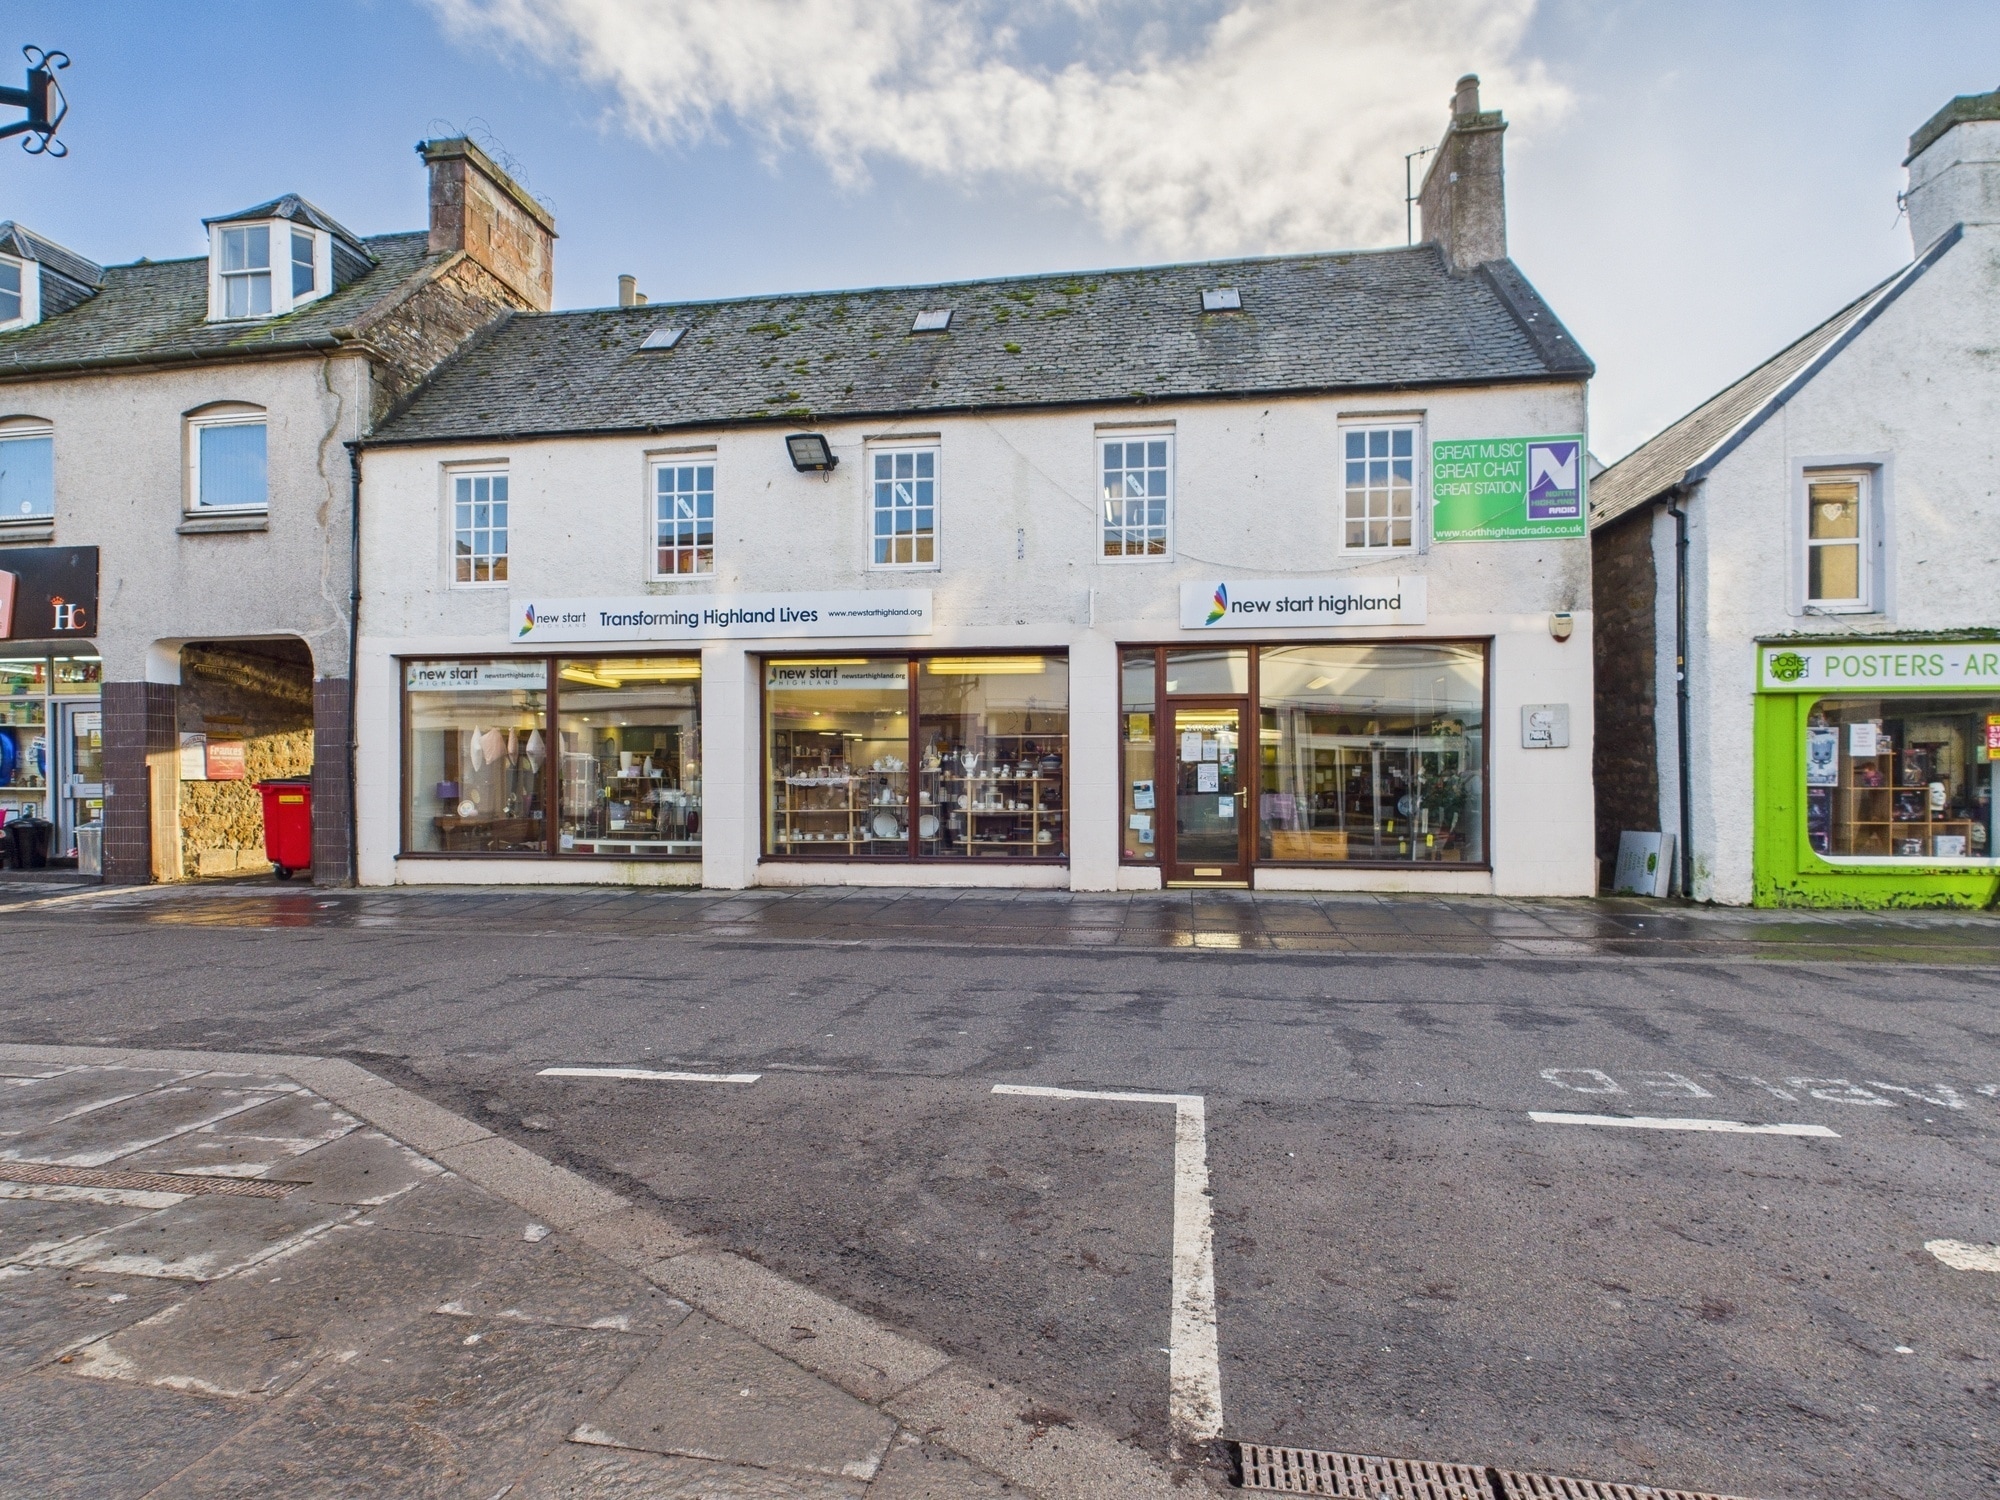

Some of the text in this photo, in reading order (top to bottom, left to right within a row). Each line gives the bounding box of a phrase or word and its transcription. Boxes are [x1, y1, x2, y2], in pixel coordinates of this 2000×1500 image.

[1434, 443, 1523, 460] GREAT MUSIC
[1434, 461, 1522, 479] GREAT CHAT
[1434, 481, 1522, 496] GREAT STATION
[1531, 498, 1576, 506] HIGHLAND
[1436, 525, 1582, 538] www.northhighlandradio.co.uk
[1232, 594, 1401, 615] new start highland
[536, 612, 586, 624] new start
[600, 606, 818, 628] Transforming Highland Lives
[828, 608, 923, 618] www.newstarthighland.org
[1770, 653, 1811, 667] Poster
[1825, 654, 1944, 677] POSTERS
[419, 667, 478, 679] new start
[484, 671, 546, 679] newstarthighland.org
[779, 667, 838, 679] new start
[842, 672, 906, 680] newstarthighland.org
